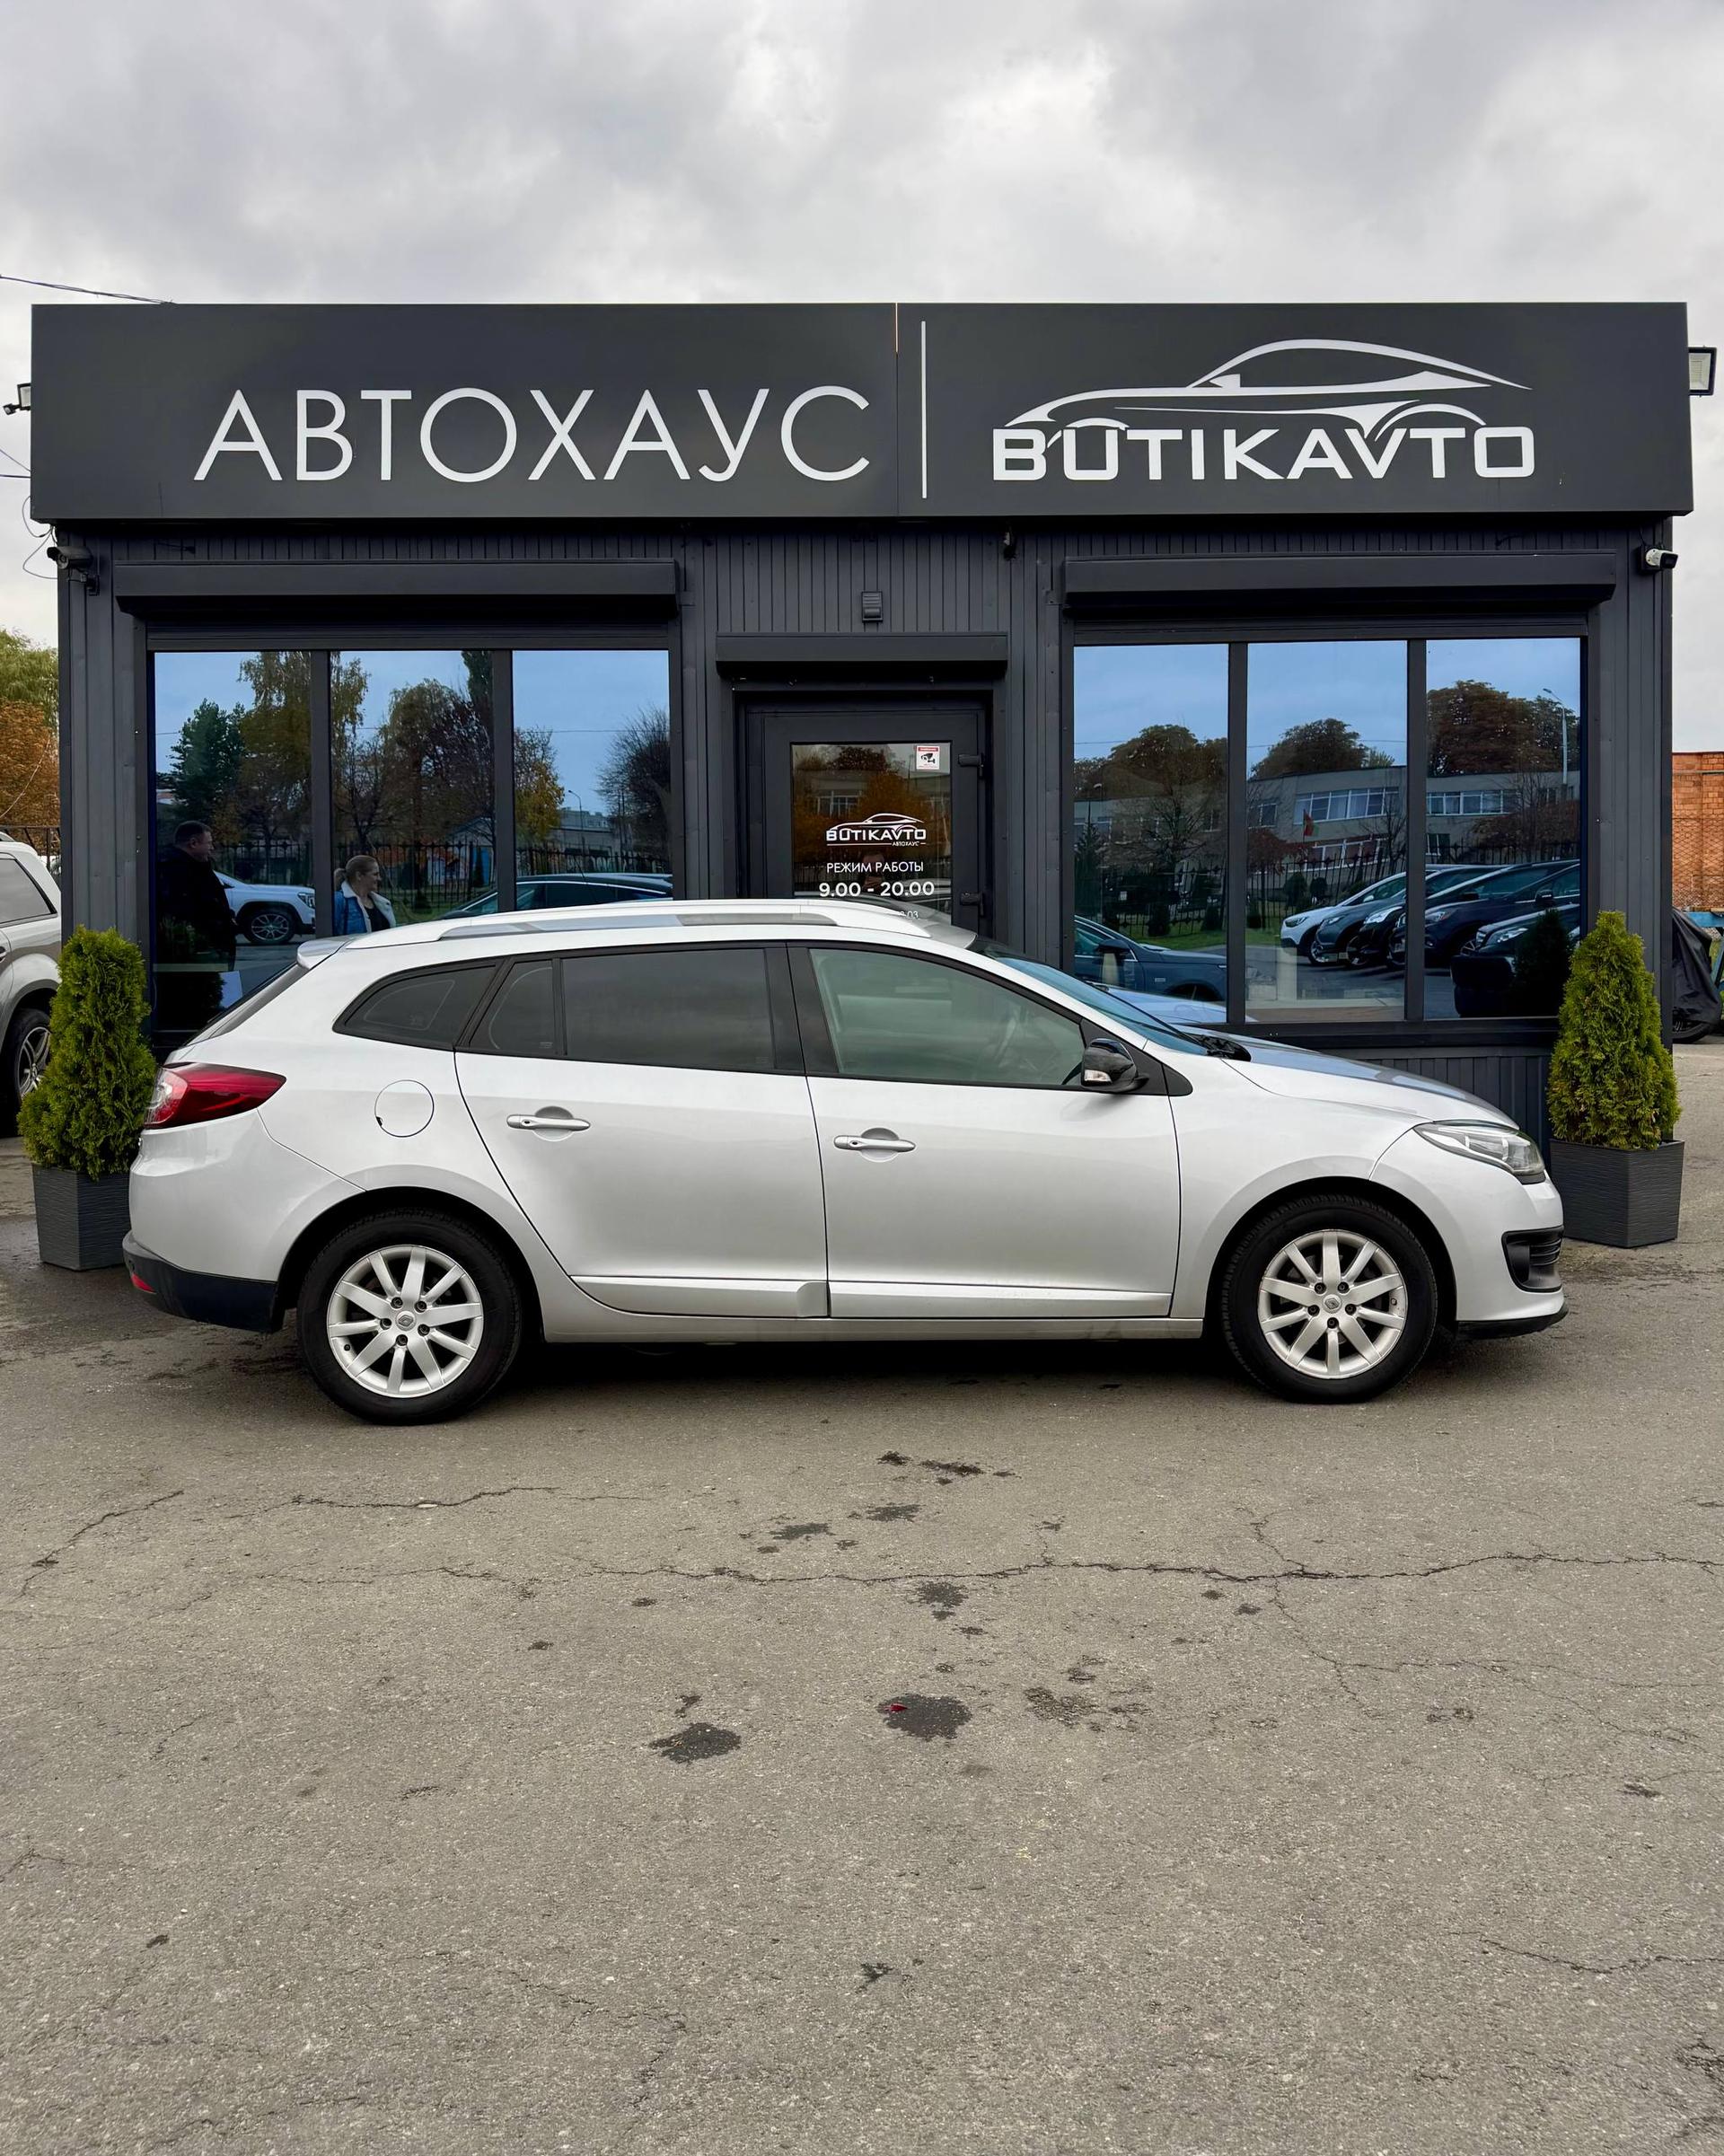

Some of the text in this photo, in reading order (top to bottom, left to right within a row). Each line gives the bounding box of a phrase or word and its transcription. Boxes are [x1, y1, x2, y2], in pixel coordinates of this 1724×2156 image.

[193, 385, 871, 483] АВТОХАУС
[992, 425, 1535, 482] BUTIKAVTO
[825, 828, 927, 841] BUTIKAVTO
[826, 861, 924, 874] РЕЖИМ РАБОТЫ
[819, 882, 861, 897] 9.00
[880, 881, 935, 896] 20.00
